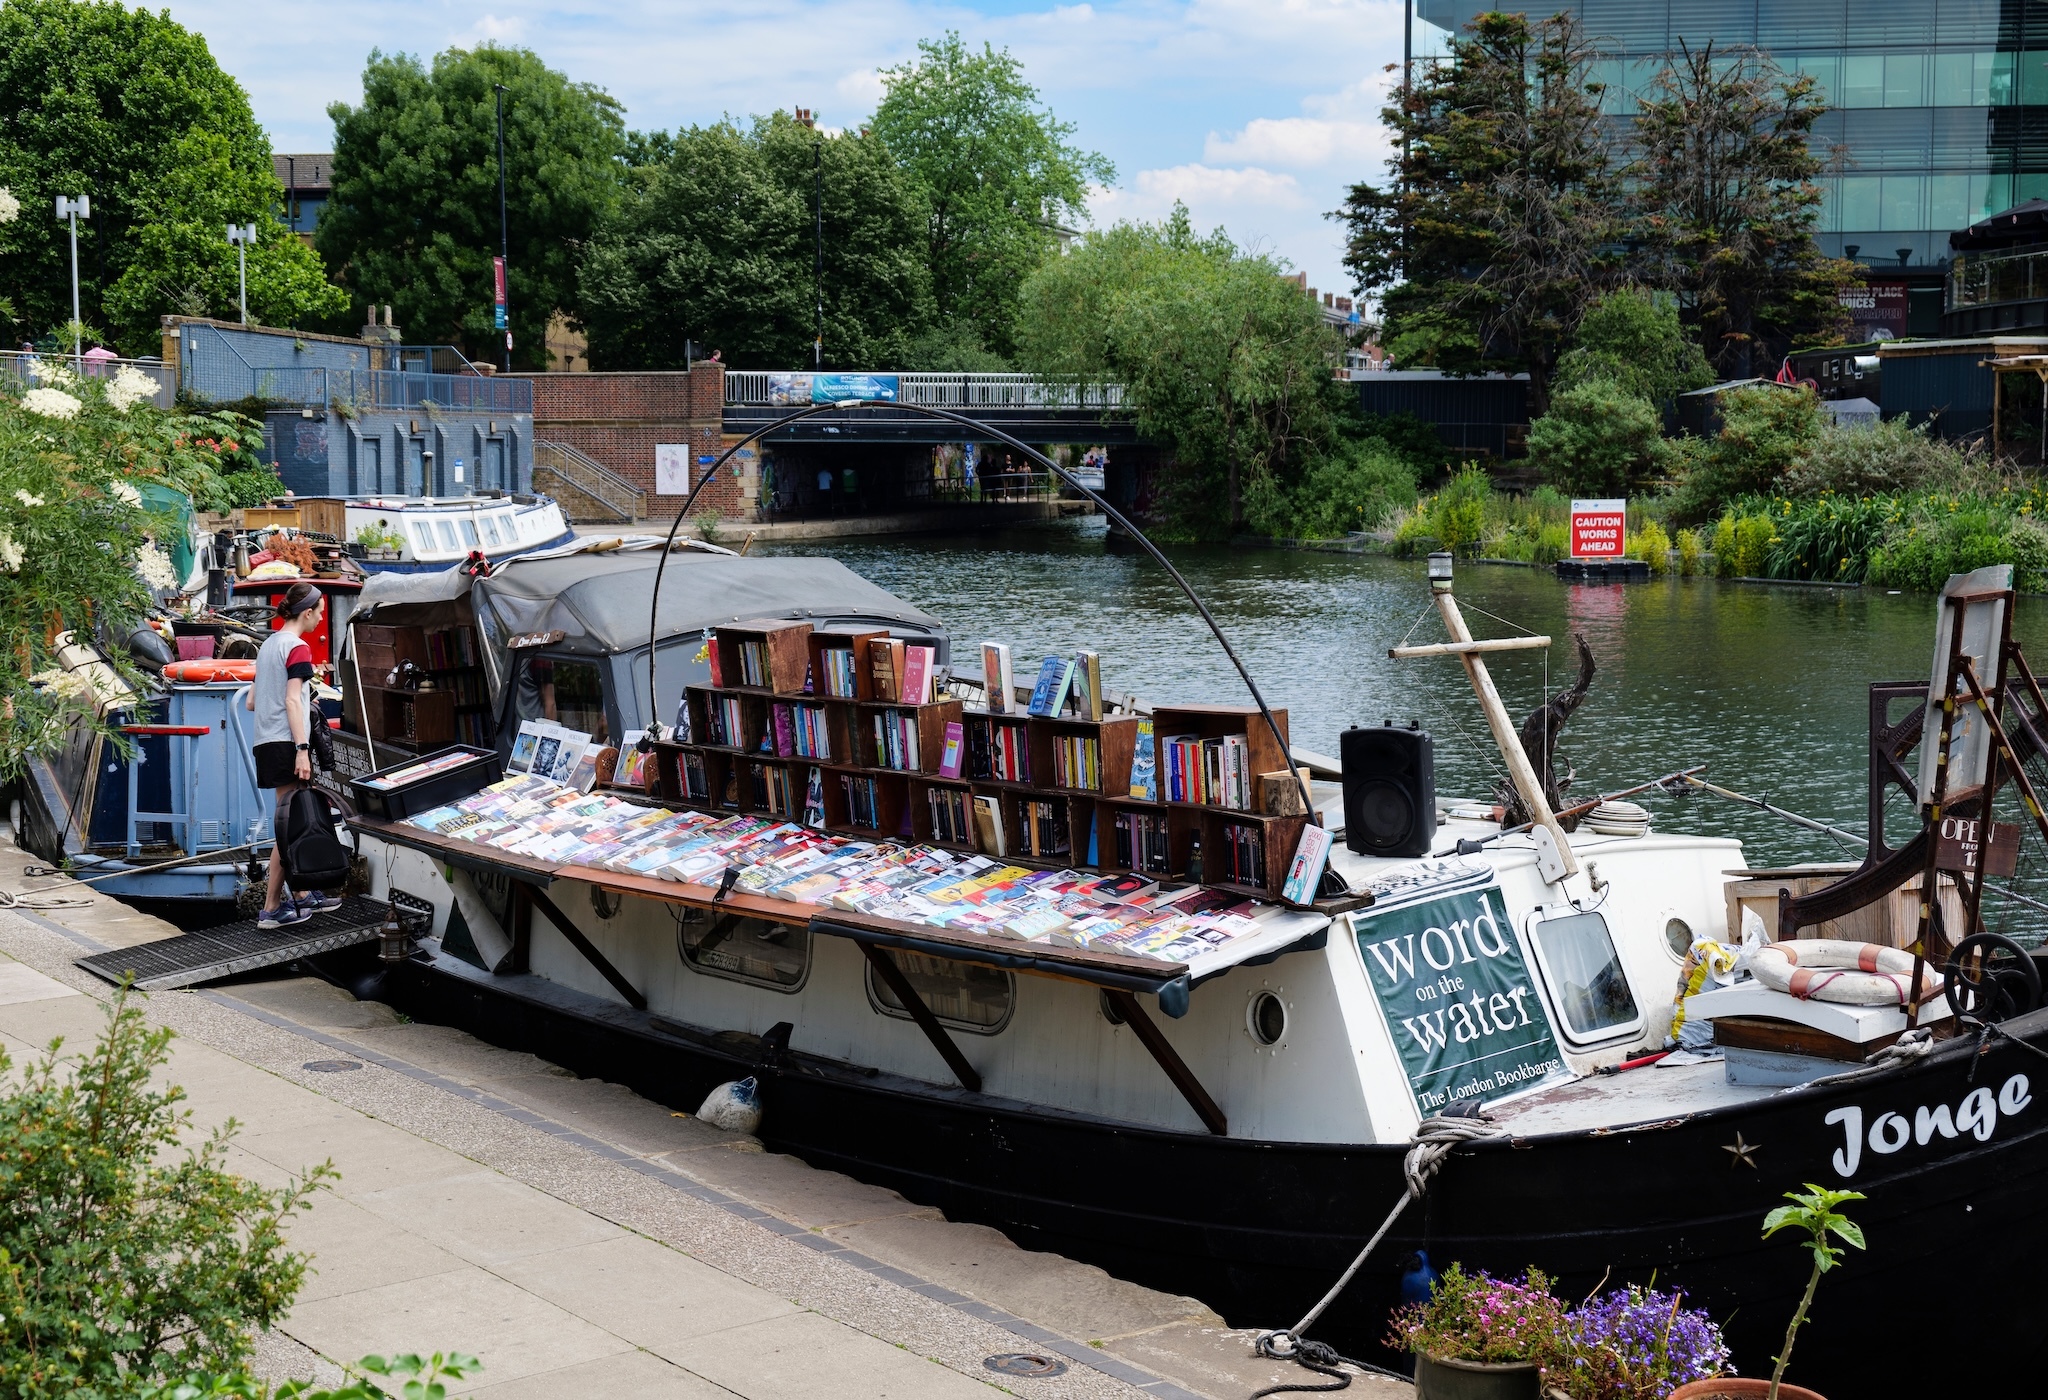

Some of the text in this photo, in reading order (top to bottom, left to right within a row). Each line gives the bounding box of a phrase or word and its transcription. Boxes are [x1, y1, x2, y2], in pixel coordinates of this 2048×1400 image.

[1838, 286, 1904, 298] KINGS PLACE
[1838, 297, 1876, 309] VOICES
[1575, 517, 1621, 527] CAUTION
[1579, 529, 1617, 539] WORKS
[1580, 541, 1616, 552] AHEAD
[1366, 893, 1510, 984] word
[1415, 974, 1465, 1002] on the
[1401, 985, 1533, 1054] water
[1418, 1058, 1561, 1111] The London Bookbarge
[1824, 1073, 2033, 1178] Jonge
